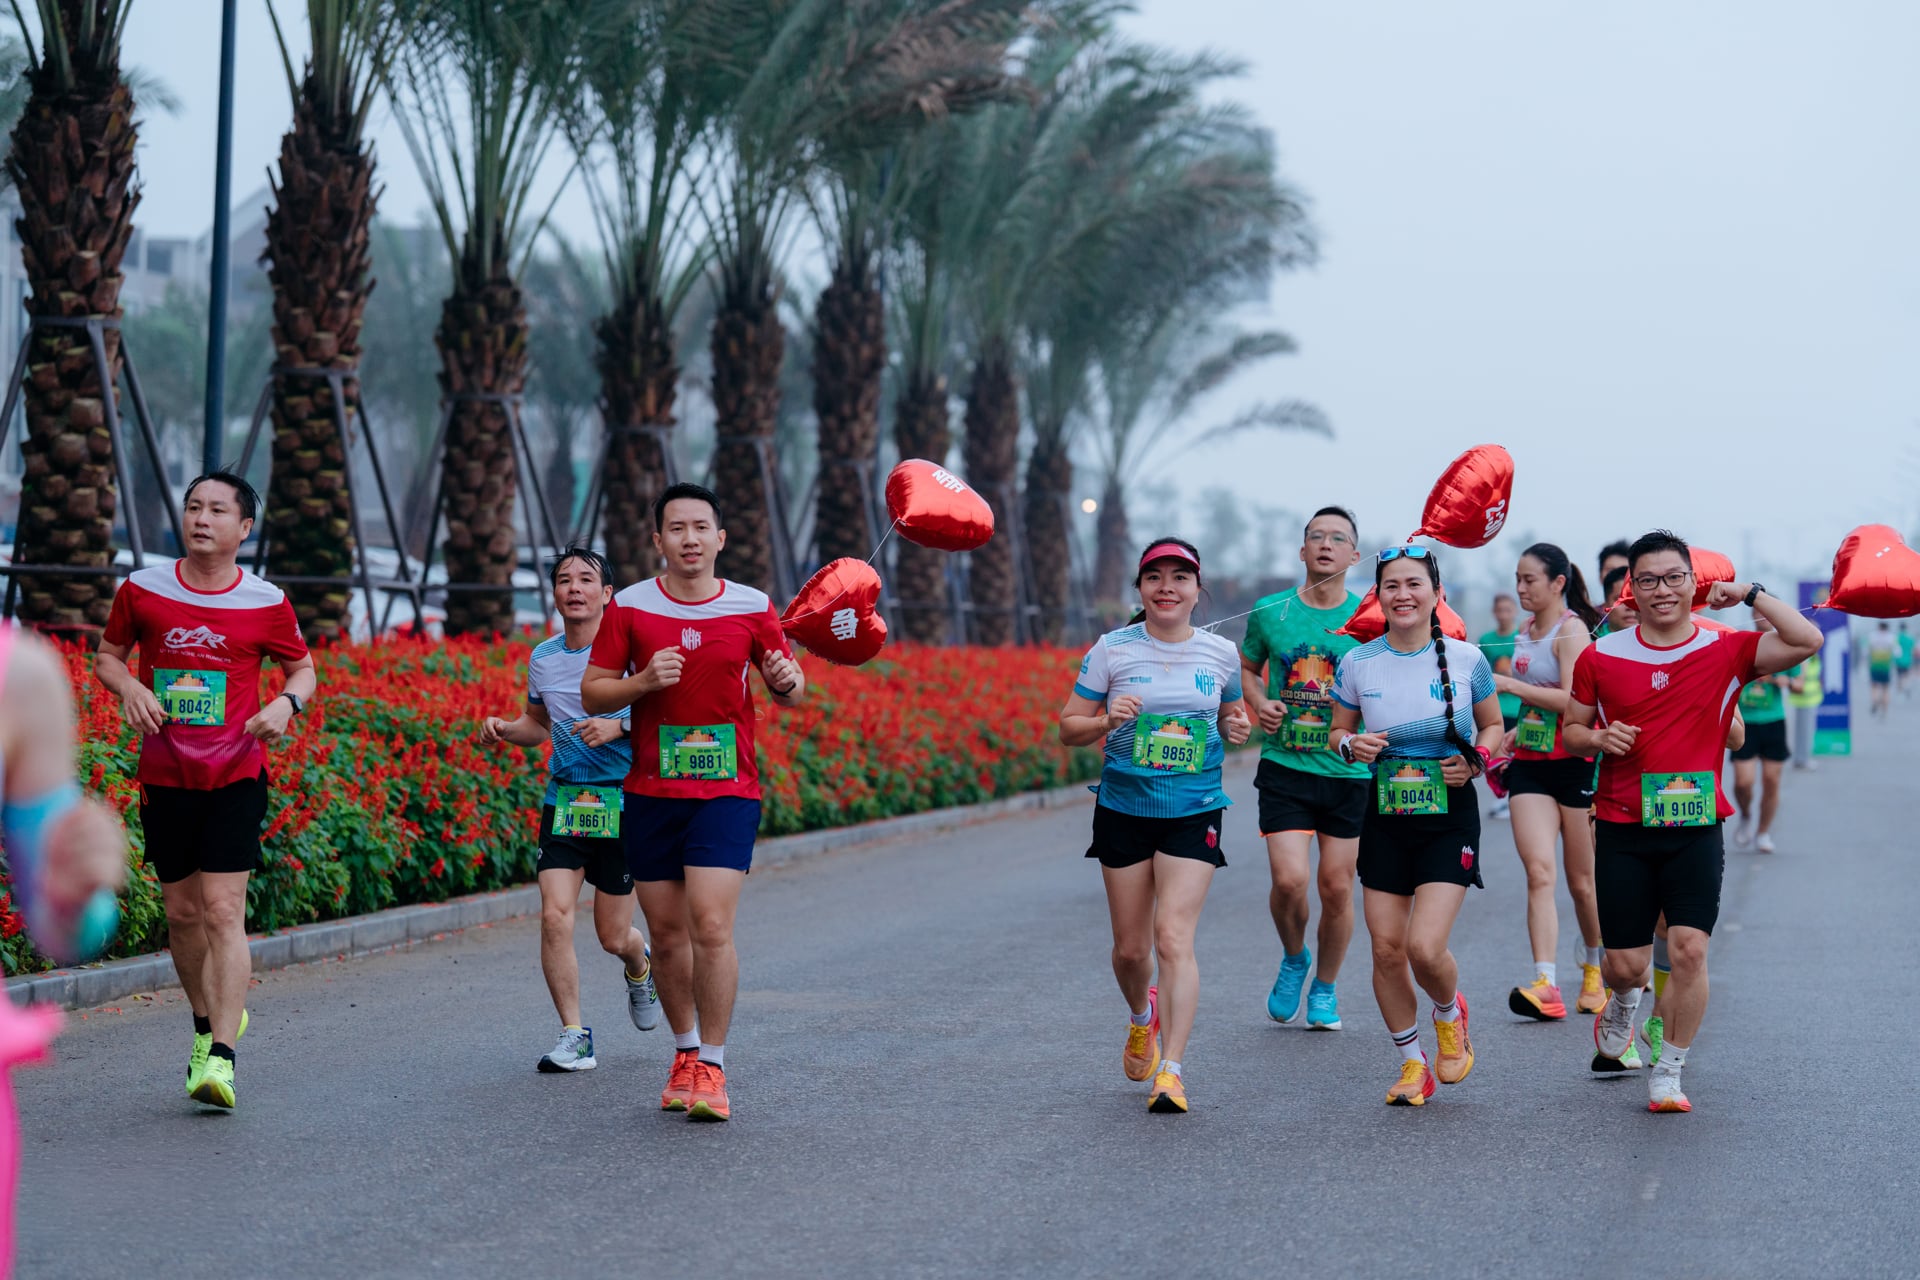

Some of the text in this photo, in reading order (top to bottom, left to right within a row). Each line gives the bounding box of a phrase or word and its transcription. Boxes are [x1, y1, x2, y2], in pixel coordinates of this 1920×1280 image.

[164, 699, 211, 714] M 8042
[1289, 730, 1329, 744] M 9440
[1147, 744, 1193, 763] F 9853
[674, 754, 722, 769] F 9881
[1388, 789, 1434, 804] M 9044
[1654, 801, 1703, 817] M 9105
[565, 813, 606, 828] M 9661
